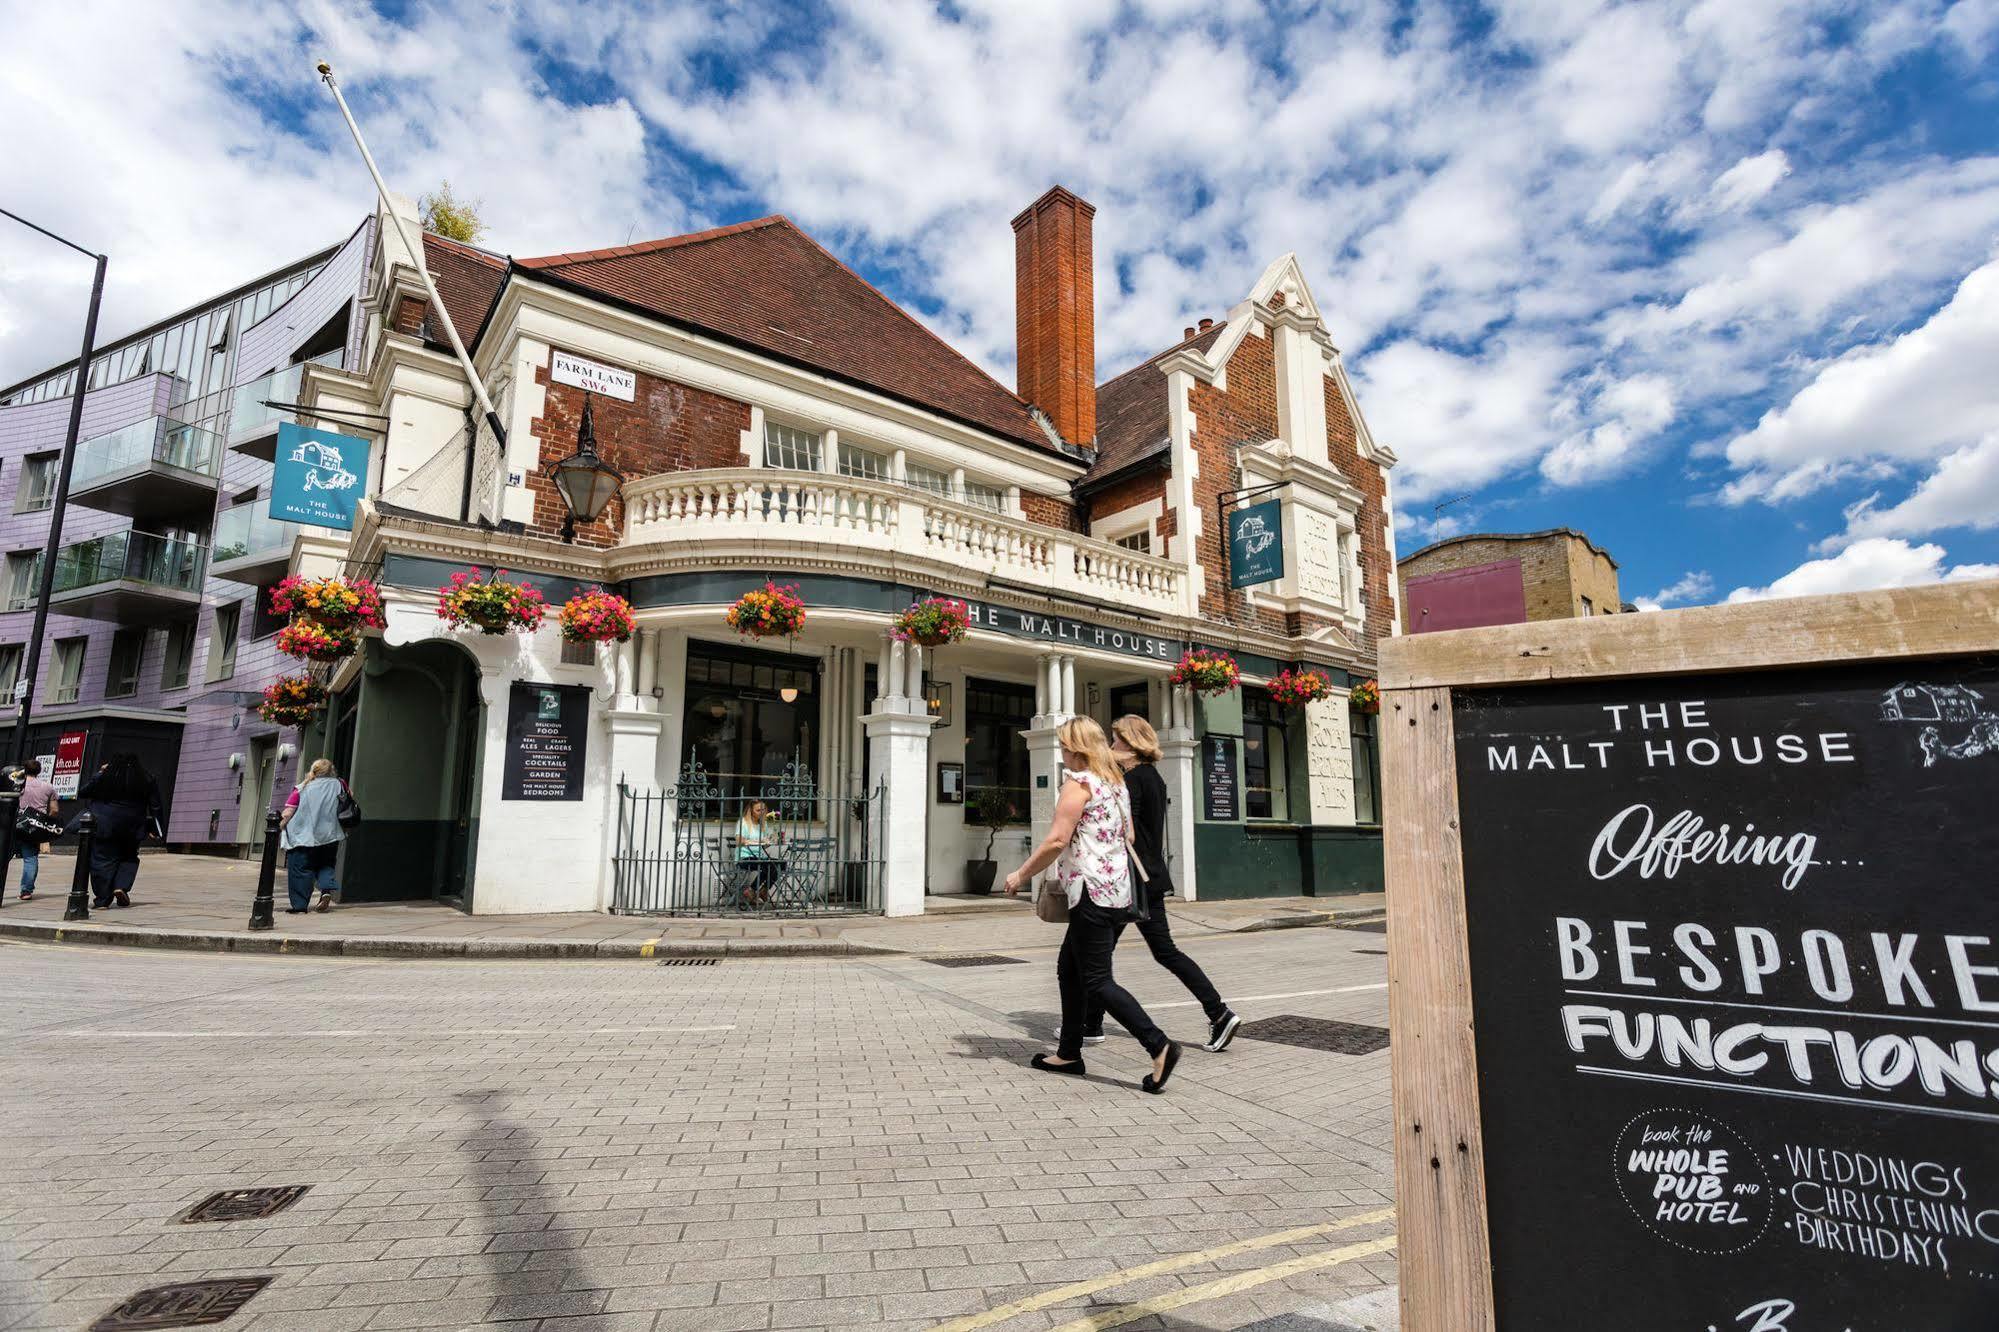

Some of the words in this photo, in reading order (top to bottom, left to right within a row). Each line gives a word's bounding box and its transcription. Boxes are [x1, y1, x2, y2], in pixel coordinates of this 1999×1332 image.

[557, 360, 592, 377] FARM
[598, 371, 632, 389] LANE
[286, 505, 311, 514] MALT
[315, 511, 347, 520] HOUSE
[309, 500, 328, 509] THE
[1239, 572, 1253, 580] MALT
[1254, 568, 1273, 577] HOUSE
[951, 601, 999, 627] HE
[1020, 615, 1081, 640] MALT
[1095, 630, 1167, 657] HOUSE
[1603, 701, 1710, 730] THE
[1487, 742, 1614, 771] MALT
[1645, 733, 1855, 767] HOUSE
[54, 777, 61, 786] TO
[62, 776, 72, 786] LET
[1642, 1125, 1681, 1145] book
[1686, 1124, 1712, 1145] the
[1628, 1149, 1729, 1175] WHOLE
[1785, 1144, 1967, 1200] WEDDINGS
[1653, 1174, 1724, 1200] PUB
[1733, 1183, 1760, 1195] AND
[1656, 1201, 1749, 1224] HOTEL
